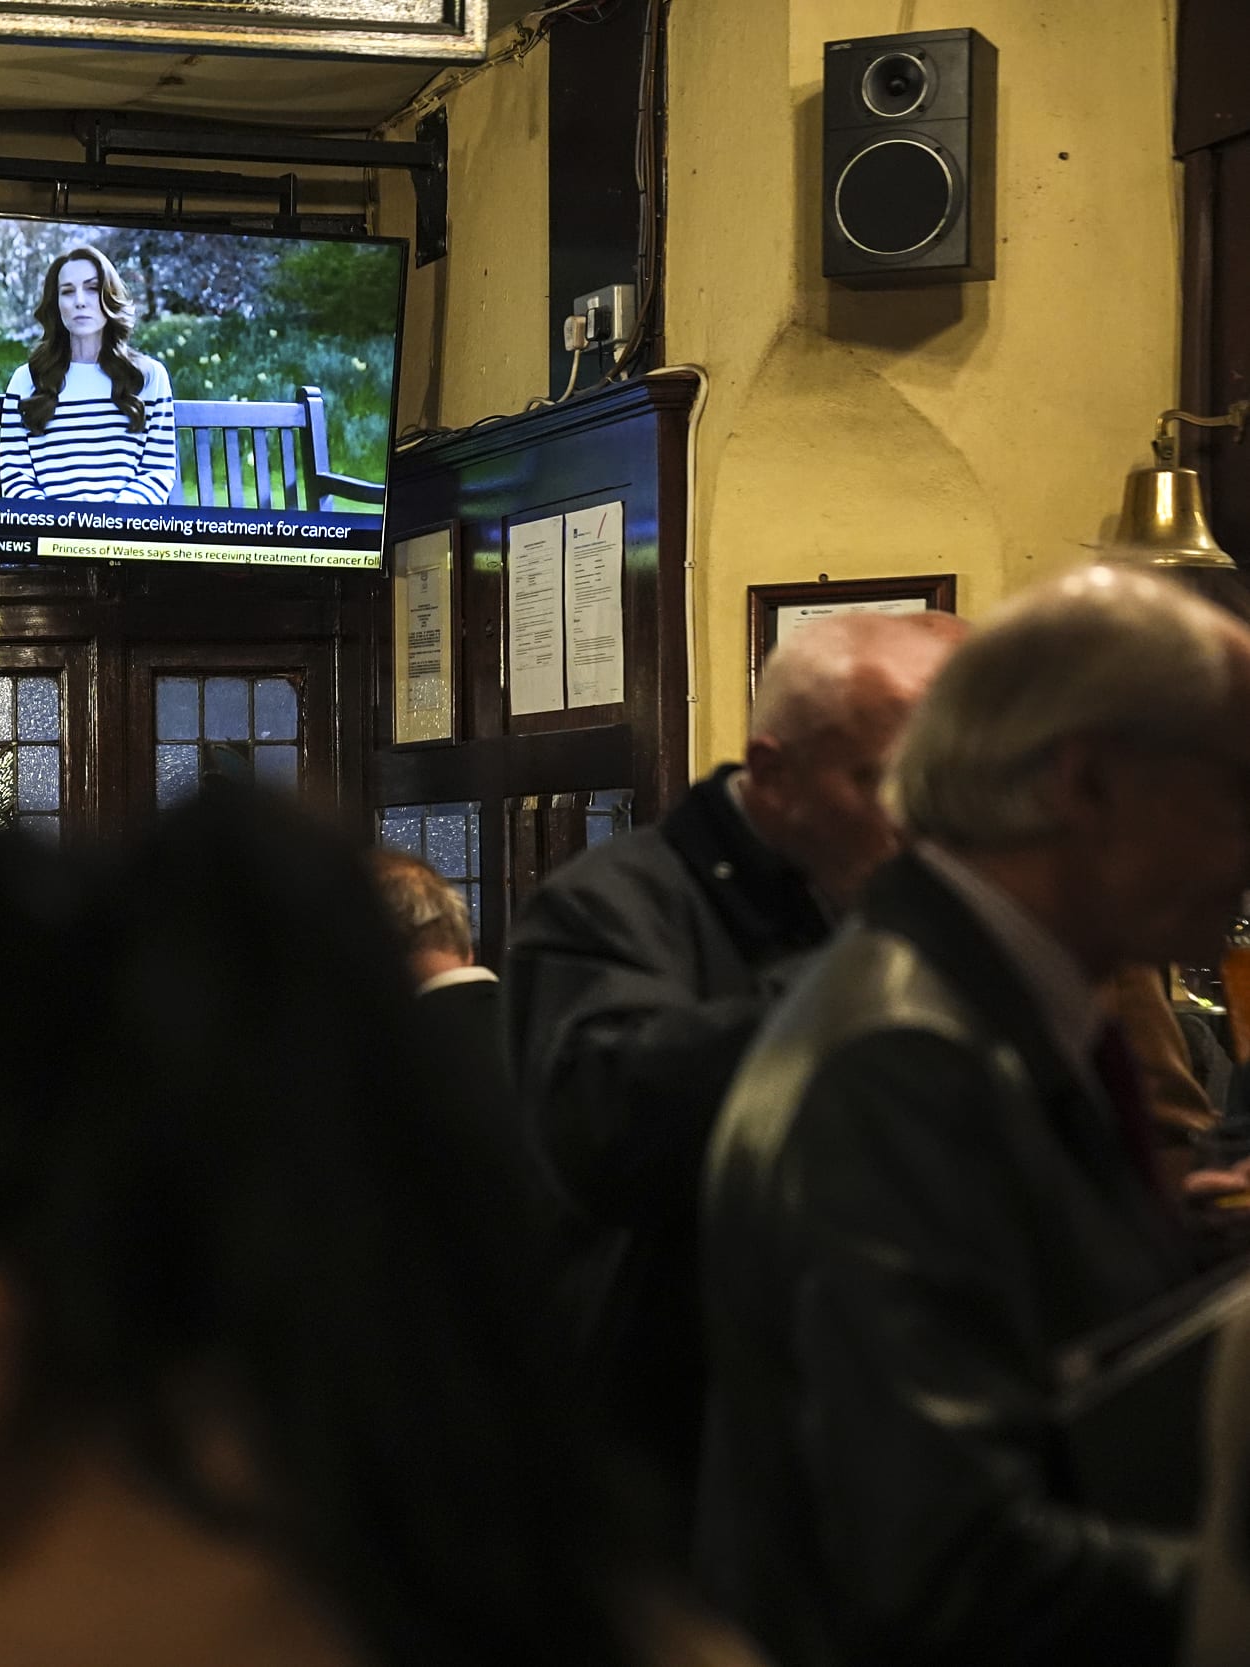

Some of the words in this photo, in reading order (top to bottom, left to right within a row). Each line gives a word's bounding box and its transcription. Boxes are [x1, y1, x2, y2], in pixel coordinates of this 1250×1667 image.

[57, 511, 76, 527] of
[77, 512, 123, 529] Wales
[126, 515, 193, 535] receiving
[196, 518, 273, 535] treatment
[276, 521, 299, 537] for
[300, 524, 352, 539] cancer
[52, 543, 97, 555] Princess
[99, 545, 111, 556] of
[112, 546, 145, 557] Wales
[147, 548, 171, 560] says
[173, 548, 192, 559] she
[194, 550, 203, 560] is
[205, 551, 252, 564] receiving
[254, 552, 308, 564] treatment
[310, 553, 326, 564] for
[327, 555, 361, 566] cancer
